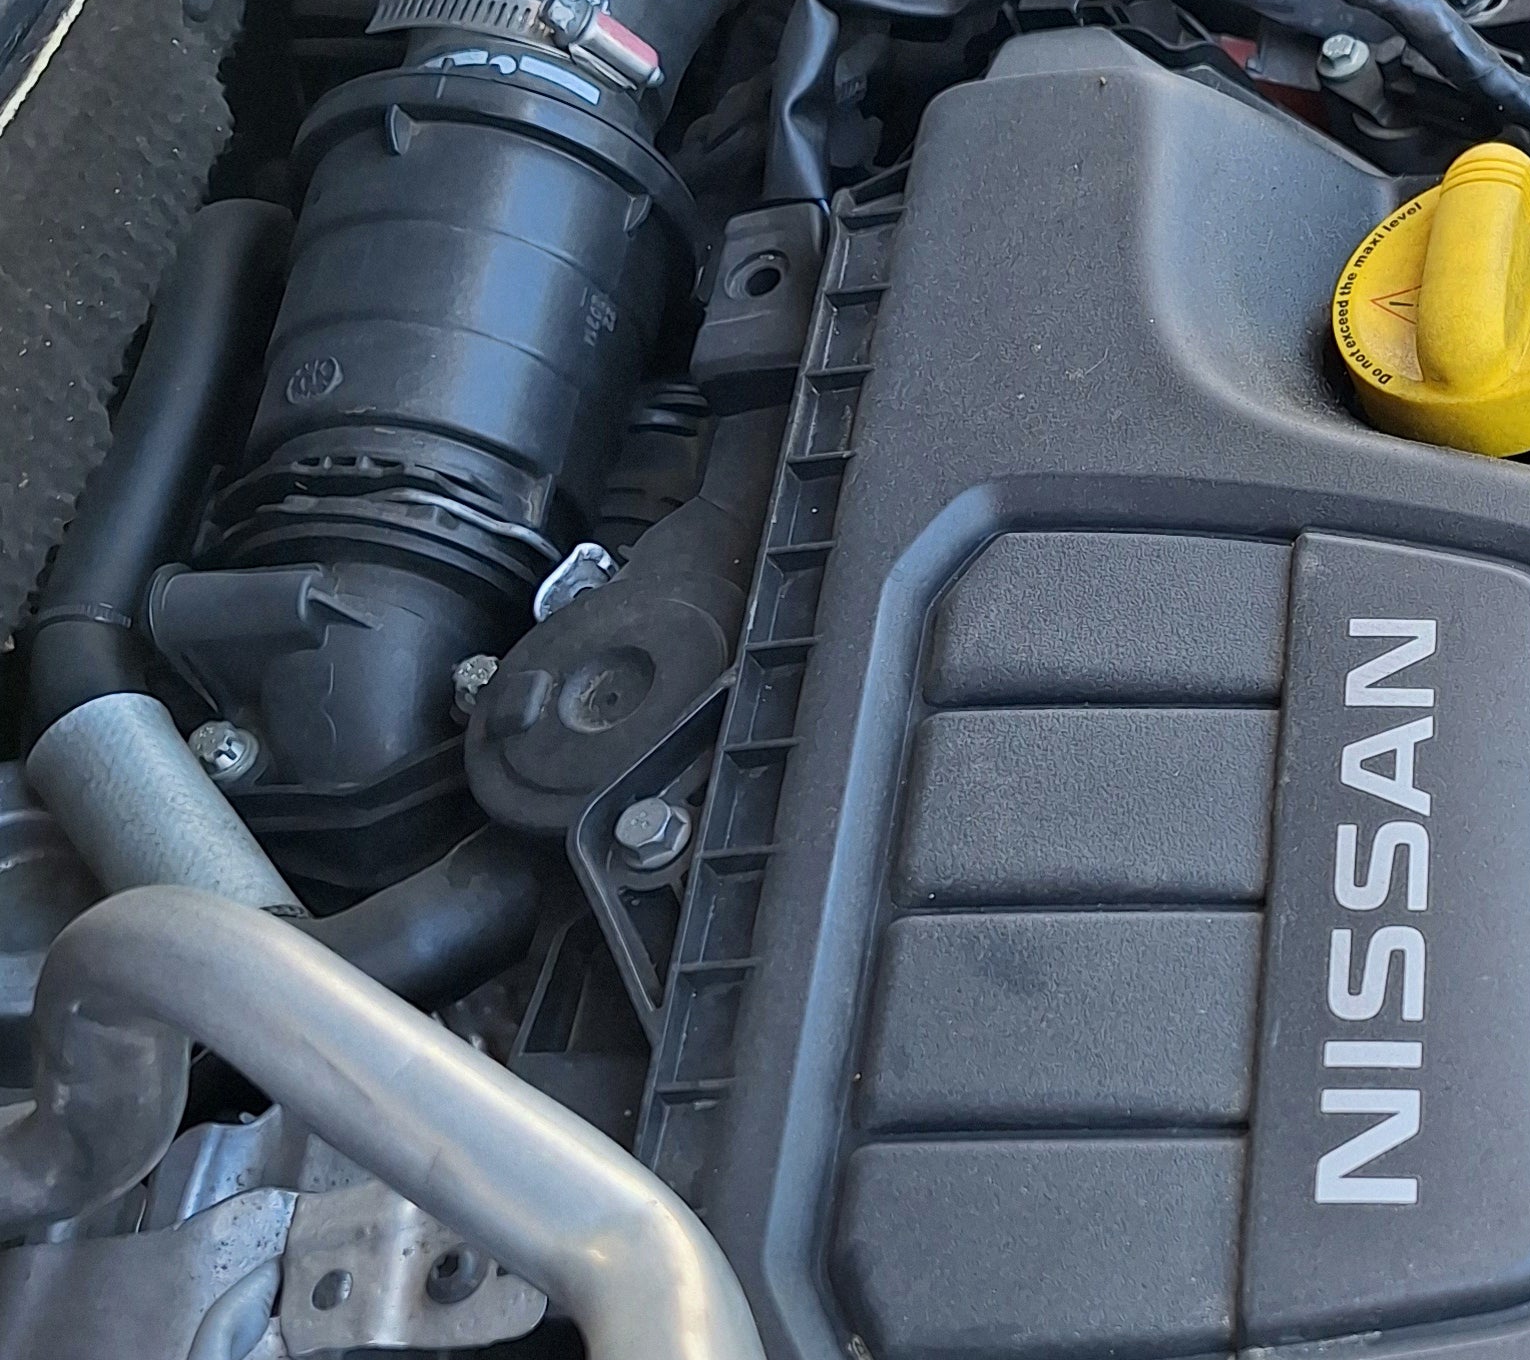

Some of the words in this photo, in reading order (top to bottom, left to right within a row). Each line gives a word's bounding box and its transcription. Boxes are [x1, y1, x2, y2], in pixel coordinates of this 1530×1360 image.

[1383, 201, 1422, 232] level
[1353, 232, 1385, 269] maxi
[1339, 272, 1358, 297] the
[1336, 300, 1357, 348] exceed
[1349, 348, 1374, 370] not
[1372, 366, 1394, 386] Do
[1314, 617, 1439, 1206] NISSAN
